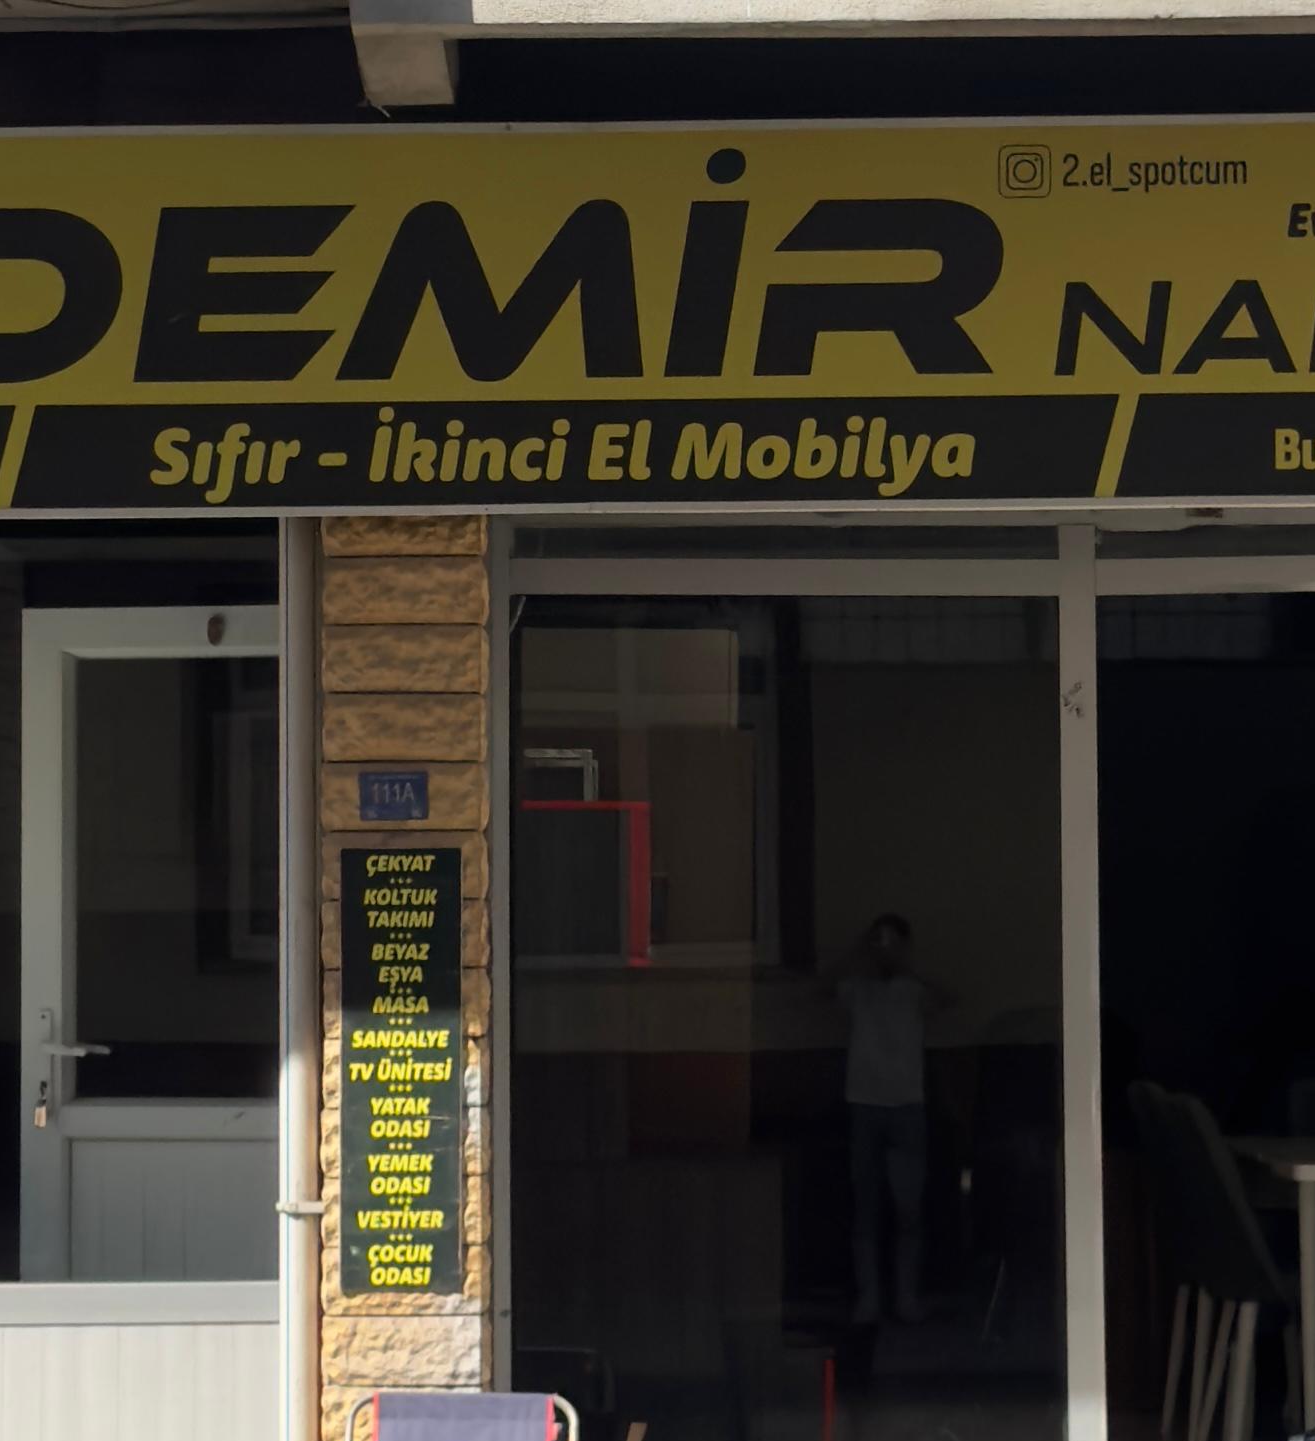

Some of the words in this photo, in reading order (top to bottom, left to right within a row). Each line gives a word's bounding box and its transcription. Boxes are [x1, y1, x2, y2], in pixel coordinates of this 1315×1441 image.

[1062, 152, 1247, 192] 2.el_spotcum
[150, 424, 300, 503] Sıfır
[370, 406, 571, 482] İkinci
[588, 422, 650, 481] El
[671, 416, 975, 496] Mobilya
[366, 854, 435, 878] ÇEKYAT
[364, 888, 438, 906] KOLTUK
[367, 911, 435, 928] TAKIMI
[371, 944, 430, 961] BEYAZ
[378, 966, 423, 988] EŞYA
[373, 996, 429, 1014] MASA
[352, 1030, 450, 1048] SANDALYE
[349, 1063, 374, 1081] TV
[377, 1057, 452, 1081] ÜNİTESİ
[370, 1098, 430, 1115] YATAK
[370, 1120, 430, 1138] ODASI
[367, 1154, 433, 1172] YEMEK
[370, 1176, 430, 1194] ODASI
[357, 1206, 444, 1228] VESTİYER
[367, 1245, 433, 1268] ÇOCUK
[370, 1268, 430, 1286] ODASI
